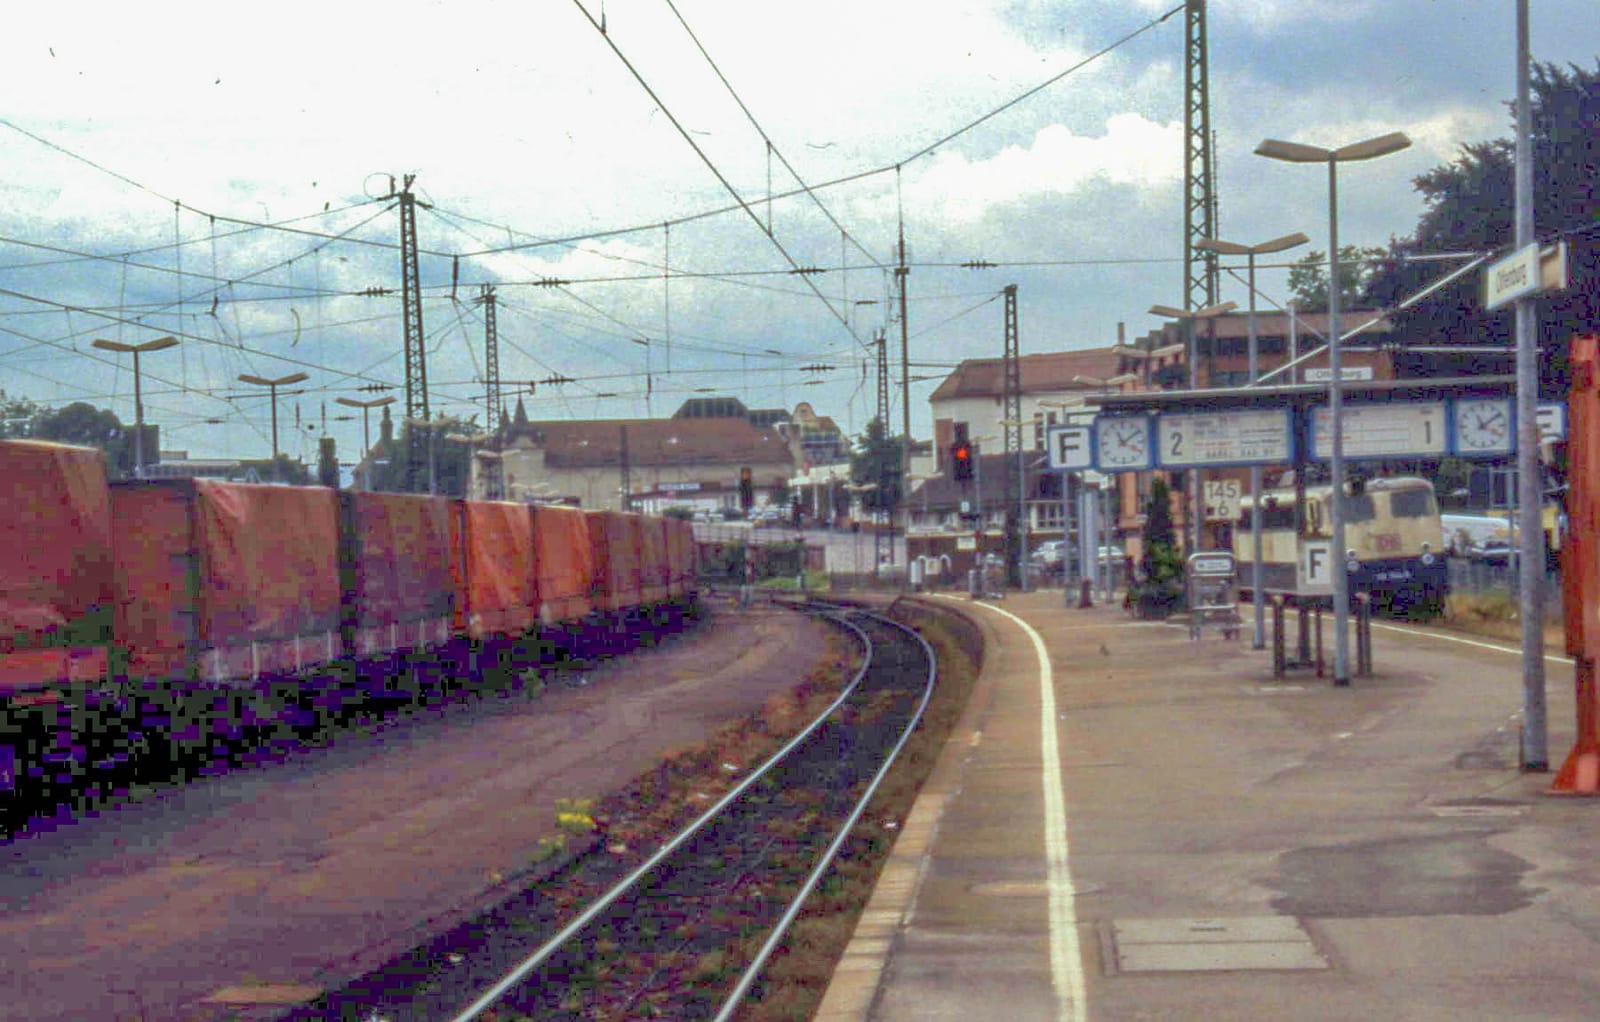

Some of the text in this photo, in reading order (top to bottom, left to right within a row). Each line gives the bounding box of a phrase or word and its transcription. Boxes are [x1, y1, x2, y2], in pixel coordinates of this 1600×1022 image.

[1170, 432, 1183, 457] 2
[1423, 420, 1432, 445] 1
[1059, 432, 1082, 464] F
[1207, 482, 1237, 499] 145
[1218, 500, 1229, 516] 6
[1309, 549, 1327, 578] F
